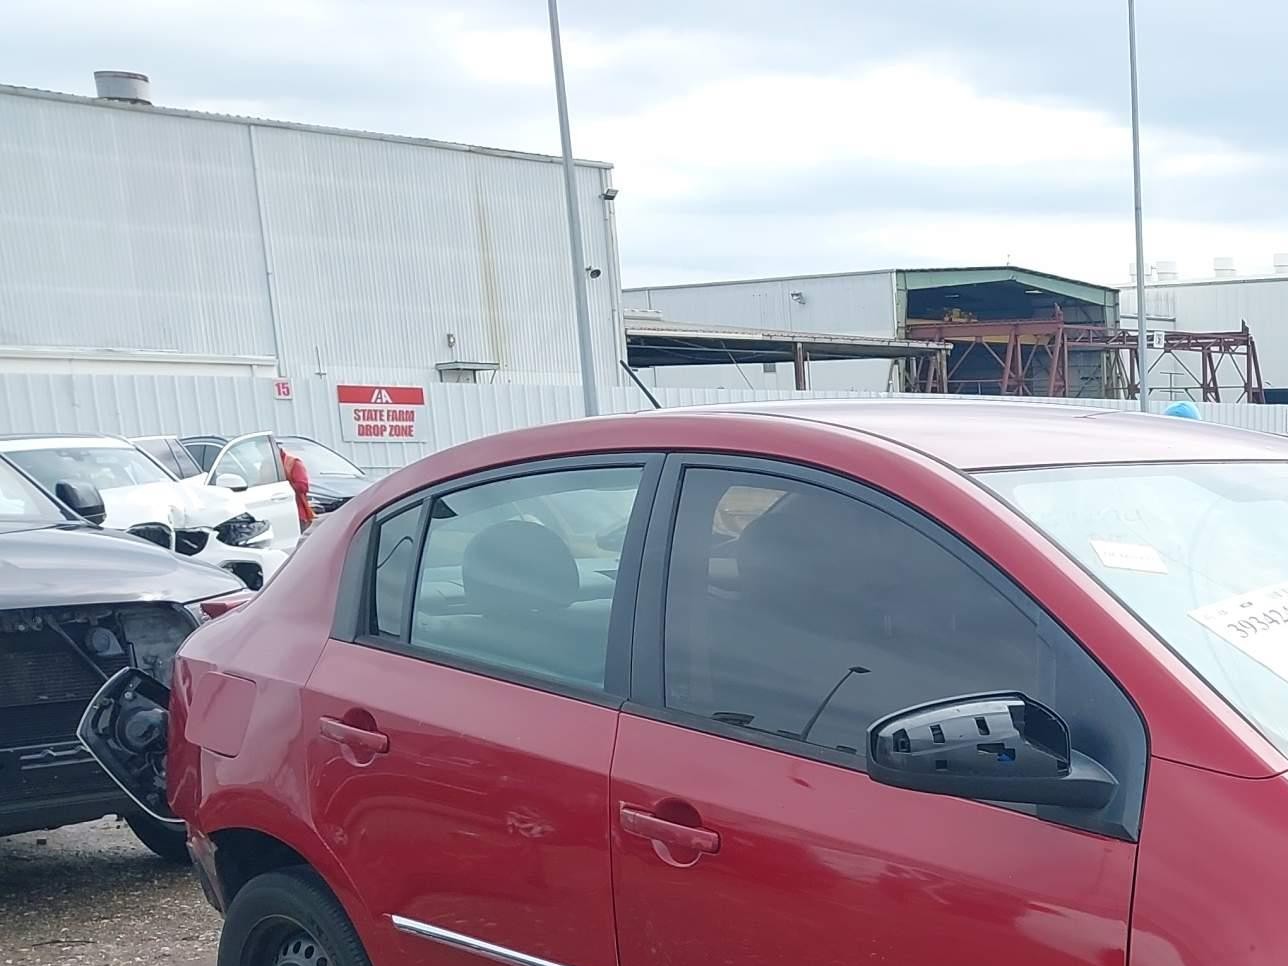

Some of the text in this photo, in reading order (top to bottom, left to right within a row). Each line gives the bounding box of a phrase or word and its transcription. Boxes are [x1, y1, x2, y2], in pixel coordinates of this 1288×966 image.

[275, 382, 290, 396] 15
[353, 408, 416, 422] STATE FARM
[357, 423, 415, 438] DROP ZONE
